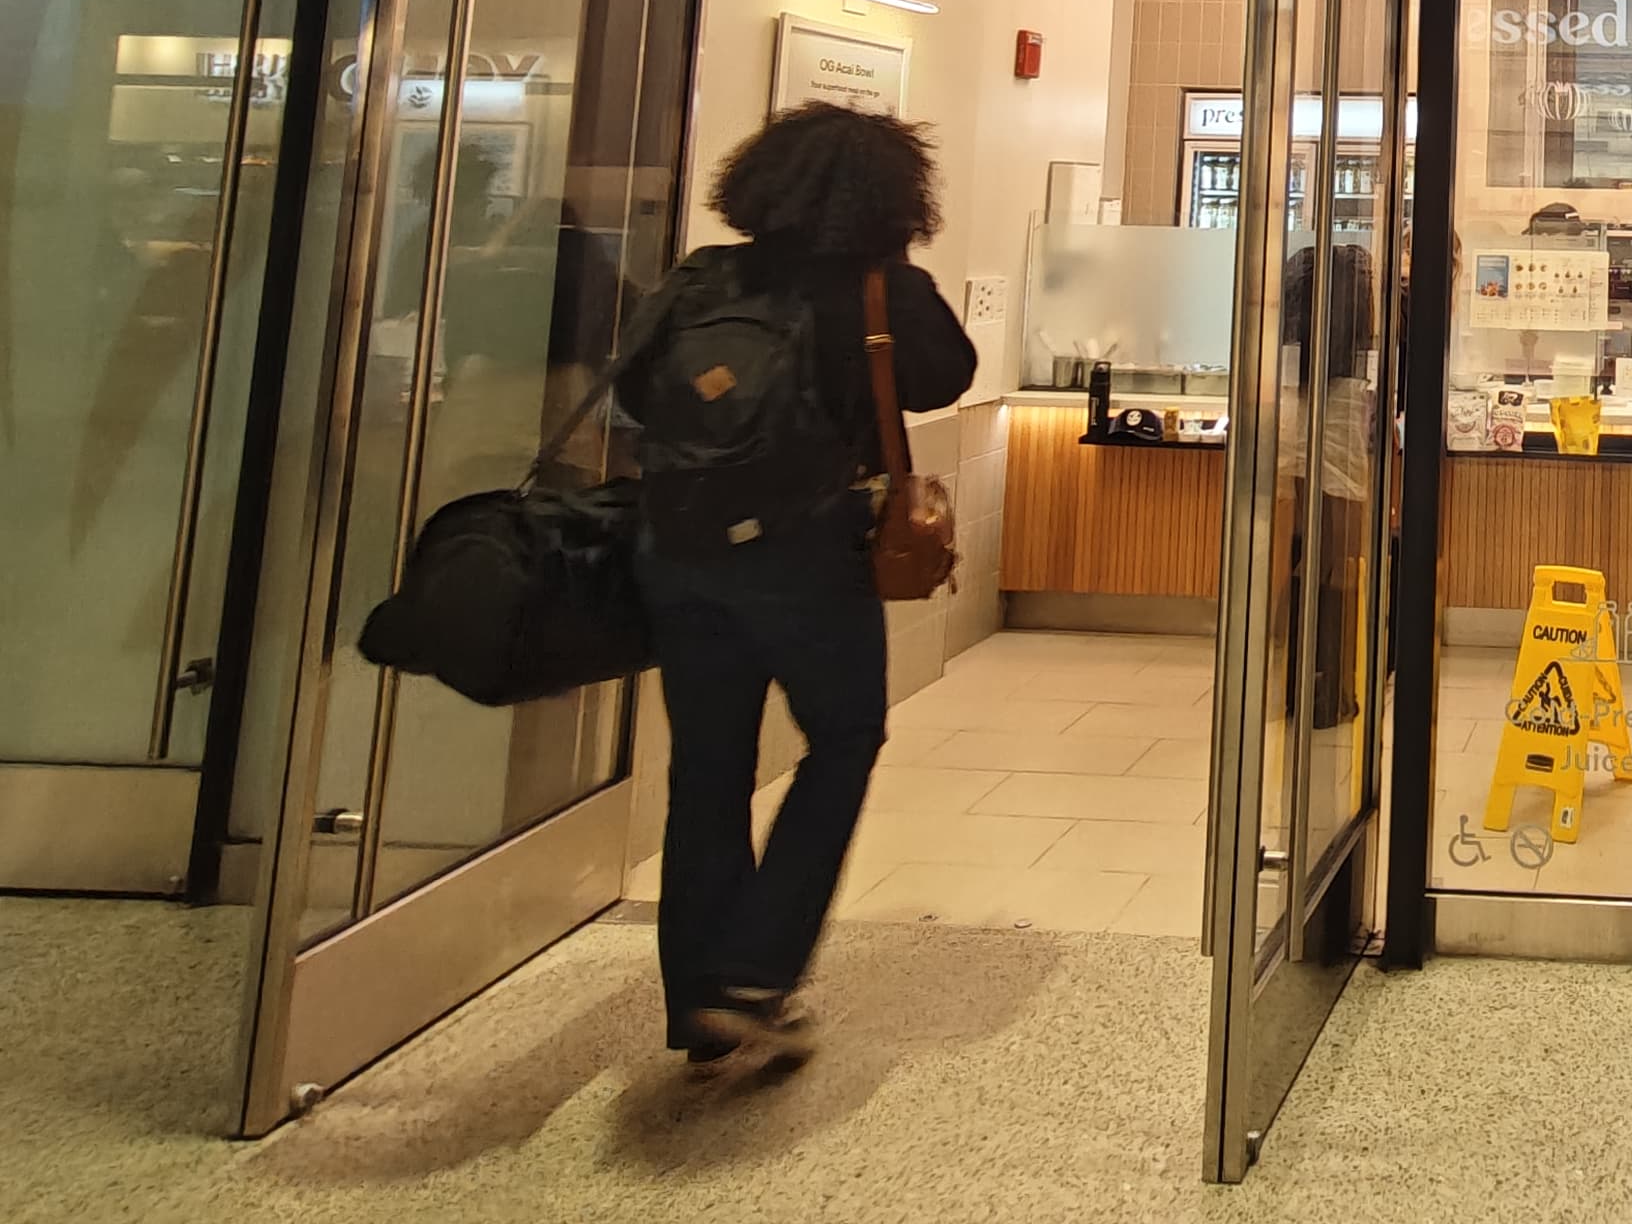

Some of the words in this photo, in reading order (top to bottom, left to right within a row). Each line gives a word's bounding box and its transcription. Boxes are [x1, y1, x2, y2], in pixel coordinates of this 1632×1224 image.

[819, 58, 835, 72] OG
[1532, 625, 1588, 645] CAUTION
[1517, 672, 1549, 713] CAUTION
[1520, 720, 1570, 738] ATTENTION
